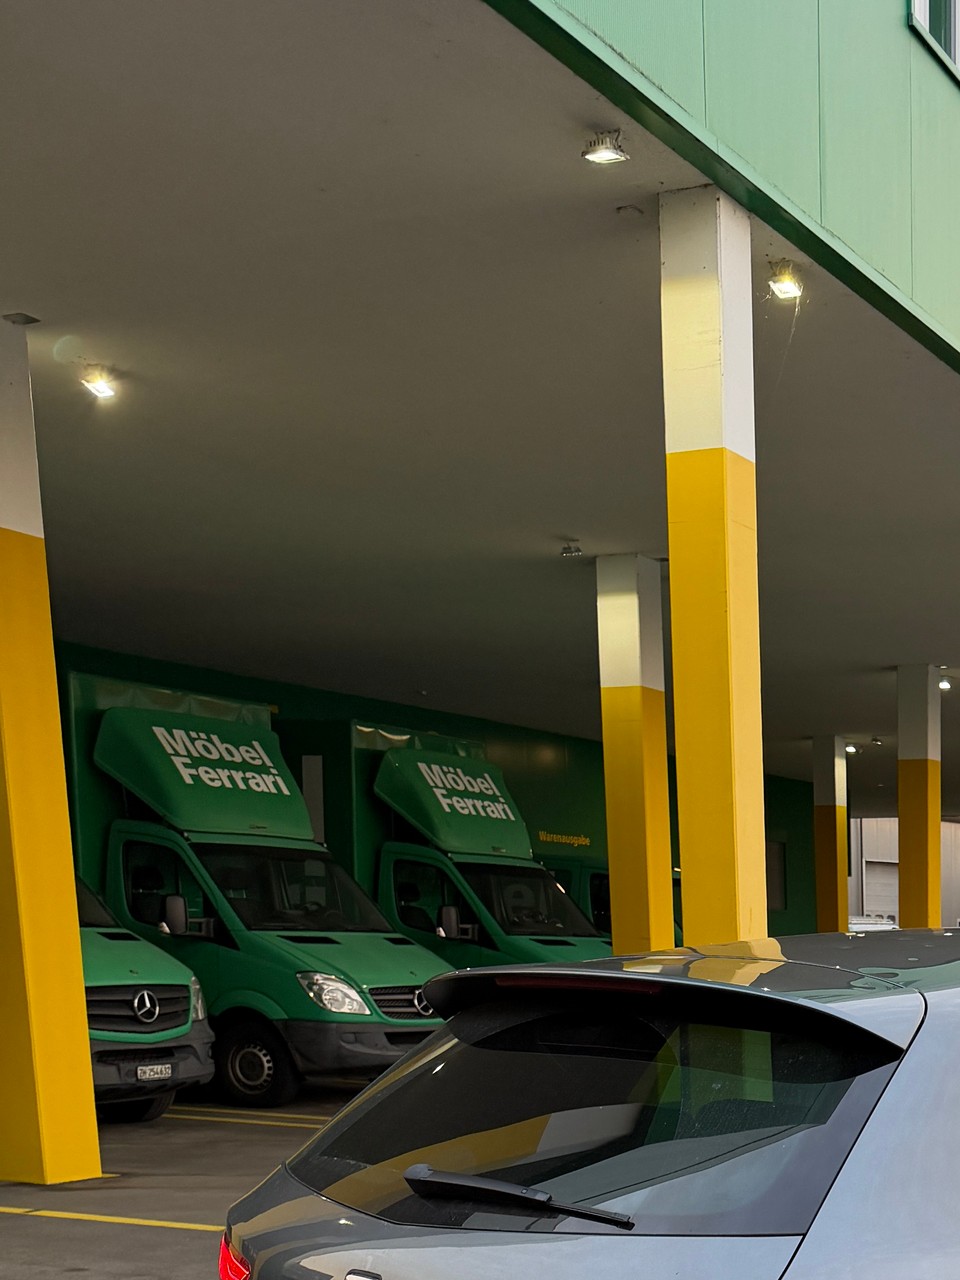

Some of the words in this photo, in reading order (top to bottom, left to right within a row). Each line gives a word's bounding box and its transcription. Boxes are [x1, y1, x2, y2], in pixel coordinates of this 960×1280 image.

[152, 726, 274, 767] Möbel
[170, 756, 290, 795] Ferrari
[417, 762, 501, 796] Möbel
[433, 787, 515, 820] Ferrari
